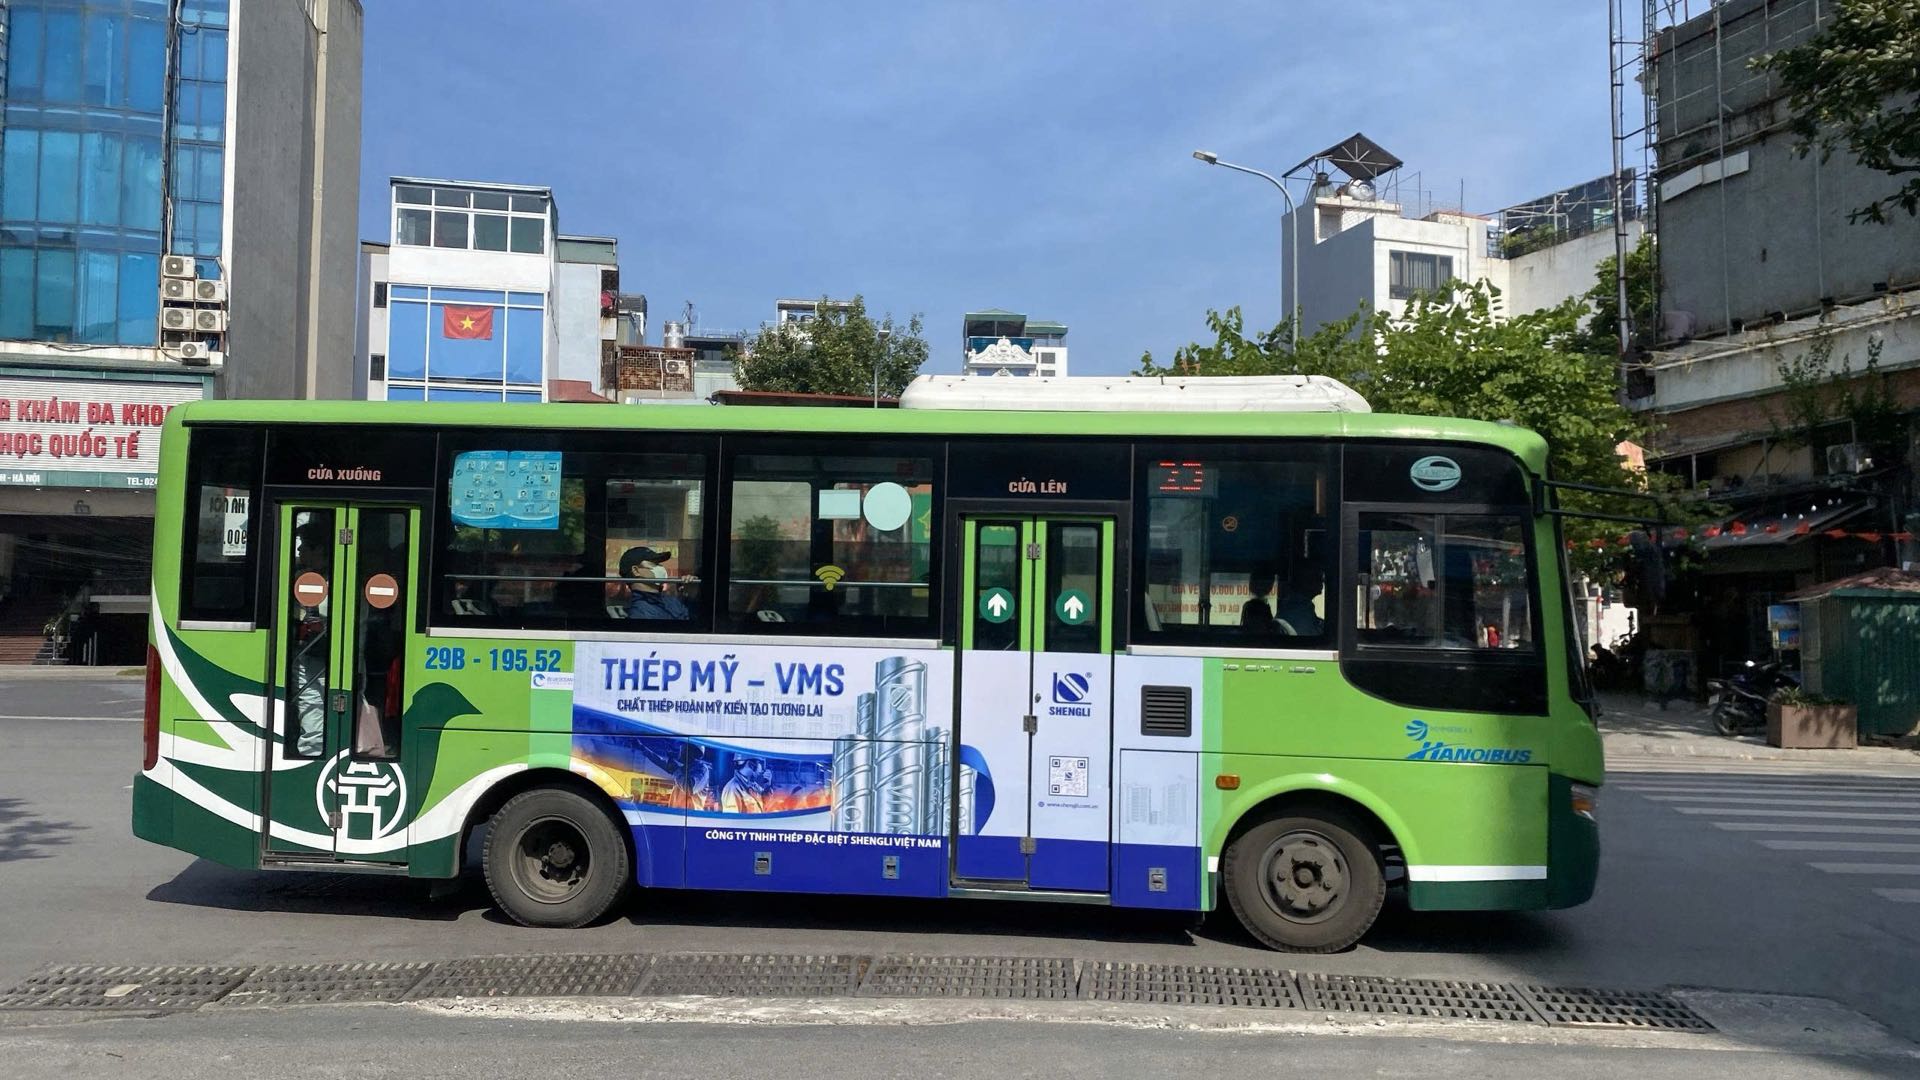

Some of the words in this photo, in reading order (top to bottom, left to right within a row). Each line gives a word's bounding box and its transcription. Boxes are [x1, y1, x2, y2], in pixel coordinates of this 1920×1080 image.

[17, 396, 81, 424] KHÁM
[87, 402, 115, 425] ĐA
[50, 427, 107, 459] QUỐC
[115, 430, 141, 459] TẾ
[127, 477, 142, 487] TEL:
[308, 464, 333, 480] CỬA
[337, 466, 382, 481] XUỐNG
[1009, 477, 1037, 493] CỬA
[1040, 479, 1067, 494] LÊN
[425, 646, 466, 670] 29B
[489, 649, 562, 672] 195.52
[601, 651, 682, 691] THÉP
[690, 654, 739, 693] MỸ
[775, 662, 845, 697] VMS
[617, 697, 646, 712] CHẤT
[647, 698, 674, 713] THÉP
[675, 699, 704, 714] HOÀN
[705, 700, 723, 714] MỸ
[724, 699, 747, 715] KIẾN
[749, 702, 769, 717] TẠO
[806, 704, 823, 717] LAI
[1049, 706, 1091, 717] SHENGLI
[1405, 742, 1532, 762] HANOIBUS
[705, 829, 734, 840] CÔNG
[735, 832, 748, 841] TY
[749, 832, 777, 841] TNHH
[778, 832, 803, 842] THÉP
[805, 833, 825, 846] ĐẶC
[828, 834, 848, 847] BIỆT
[850, 836, 893, 847] SHENGLI
[894, 837, 916, 849] VIỆT
[917, 838, 942, 849] NAM
